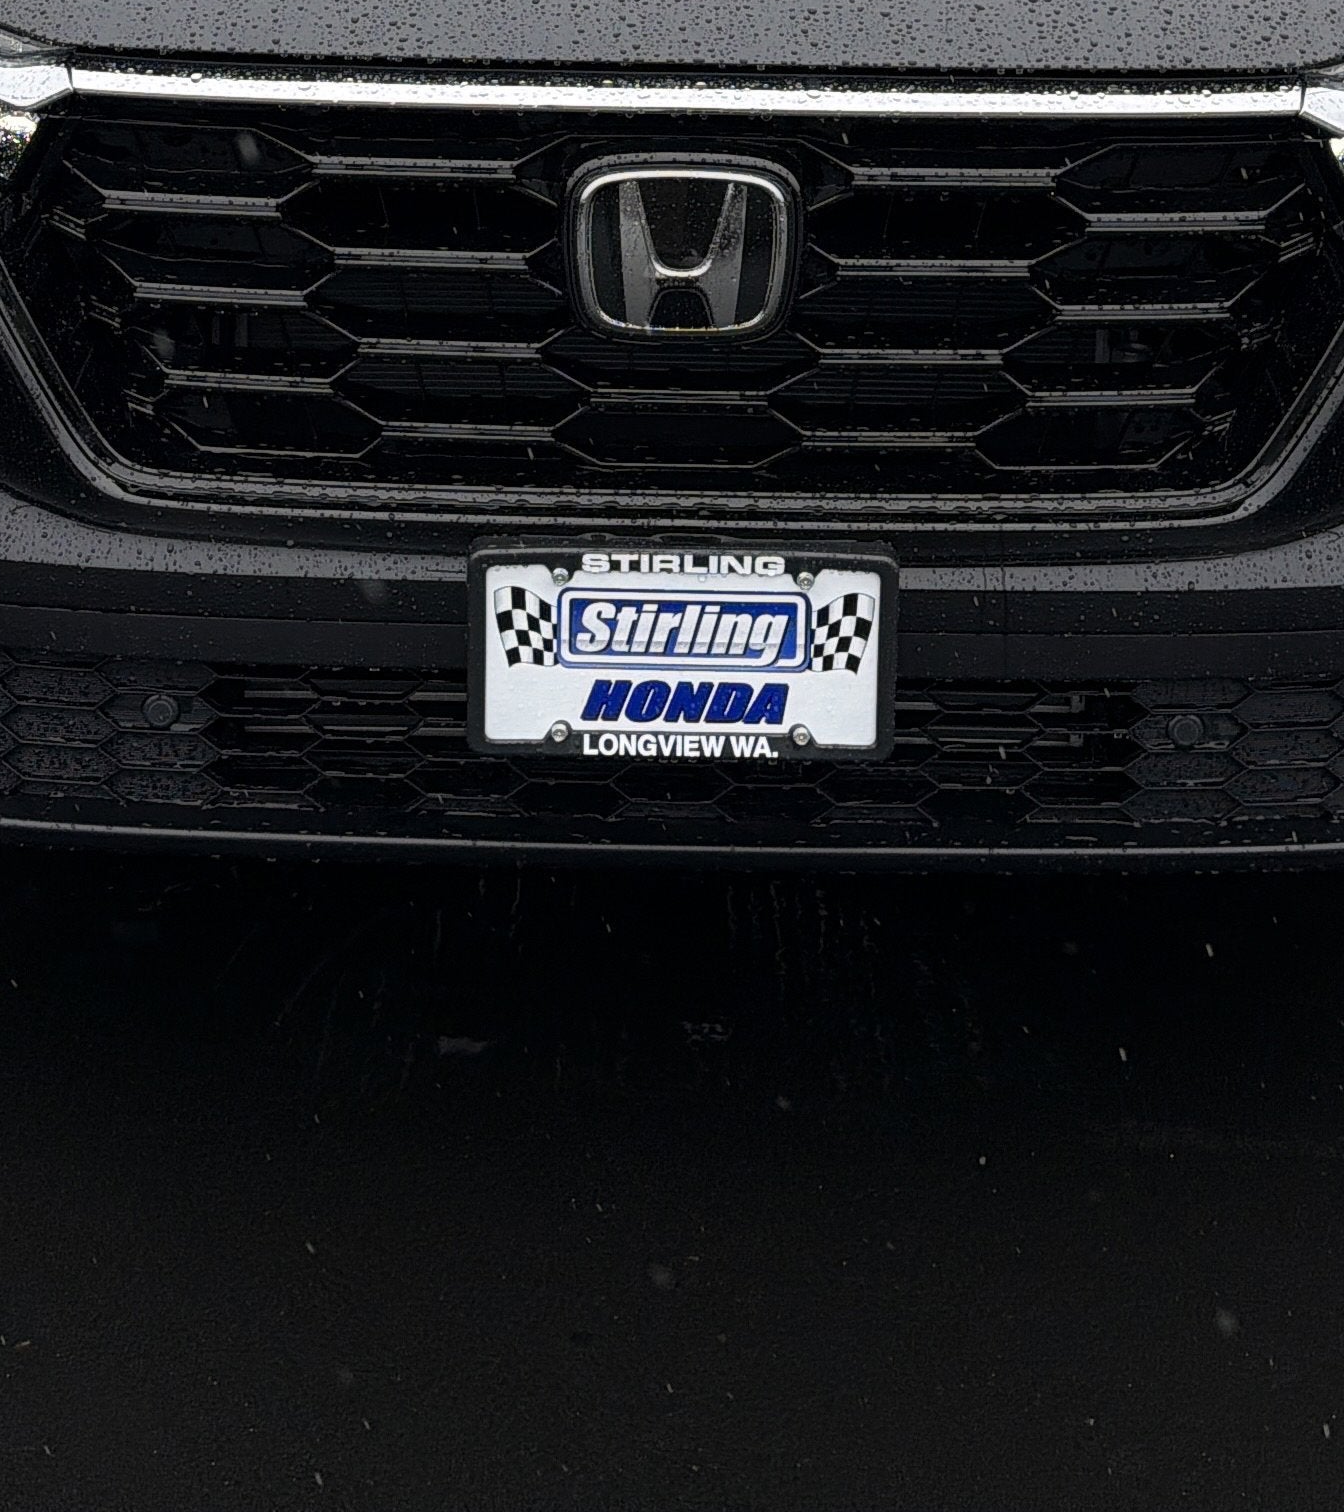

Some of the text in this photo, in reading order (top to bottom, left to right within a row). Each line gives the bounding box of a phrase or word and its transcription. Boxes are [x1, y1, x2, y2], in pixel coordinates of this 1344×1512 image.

[581, 553, 786, 576] STIRLING
[575, 601, 789, 668] Stirling
[581, 679, 789, 725] HONDA
[582, 733, 779, 759] LONGVIEW WA.
